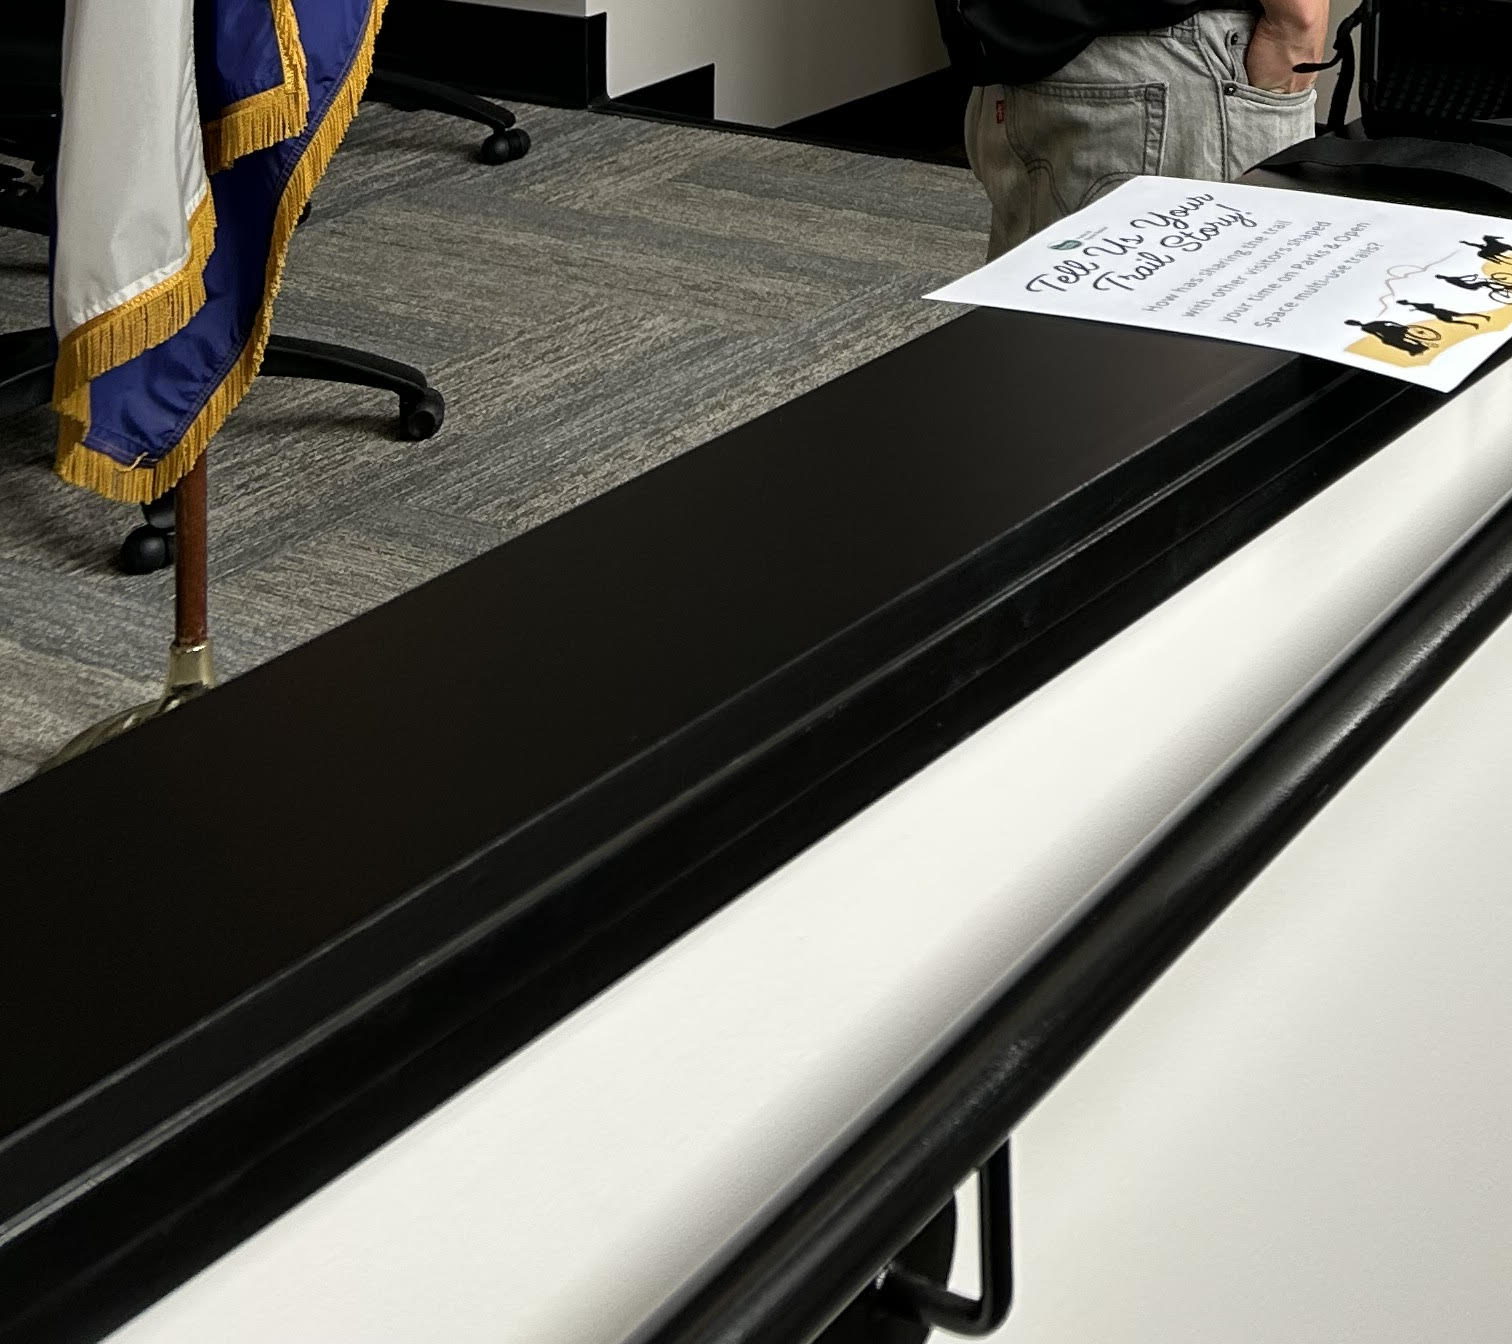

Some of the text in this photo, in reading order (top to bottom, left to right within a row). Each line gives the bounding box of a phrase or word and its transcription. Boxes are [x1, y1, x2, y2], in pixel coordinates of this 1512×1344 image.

[1025, 193, 1214, 292] Tell Us Your
[1093, 203, 1257, 291] Trail Story!
[1142, 220, 1292, 312] How has sharing the trail
[1181, 221, 1332, 317] with other visitors shaped
[1219, 302, 1252, 324] your
[1248, 283, 1282, 301] time
[1278, 272, 1299, 282] on
[1291, 250, 1331, 270] Parks
[1334, 222, 1371, 242] Open
[1254, 242, 1383, 329] Space multi-use trails?
